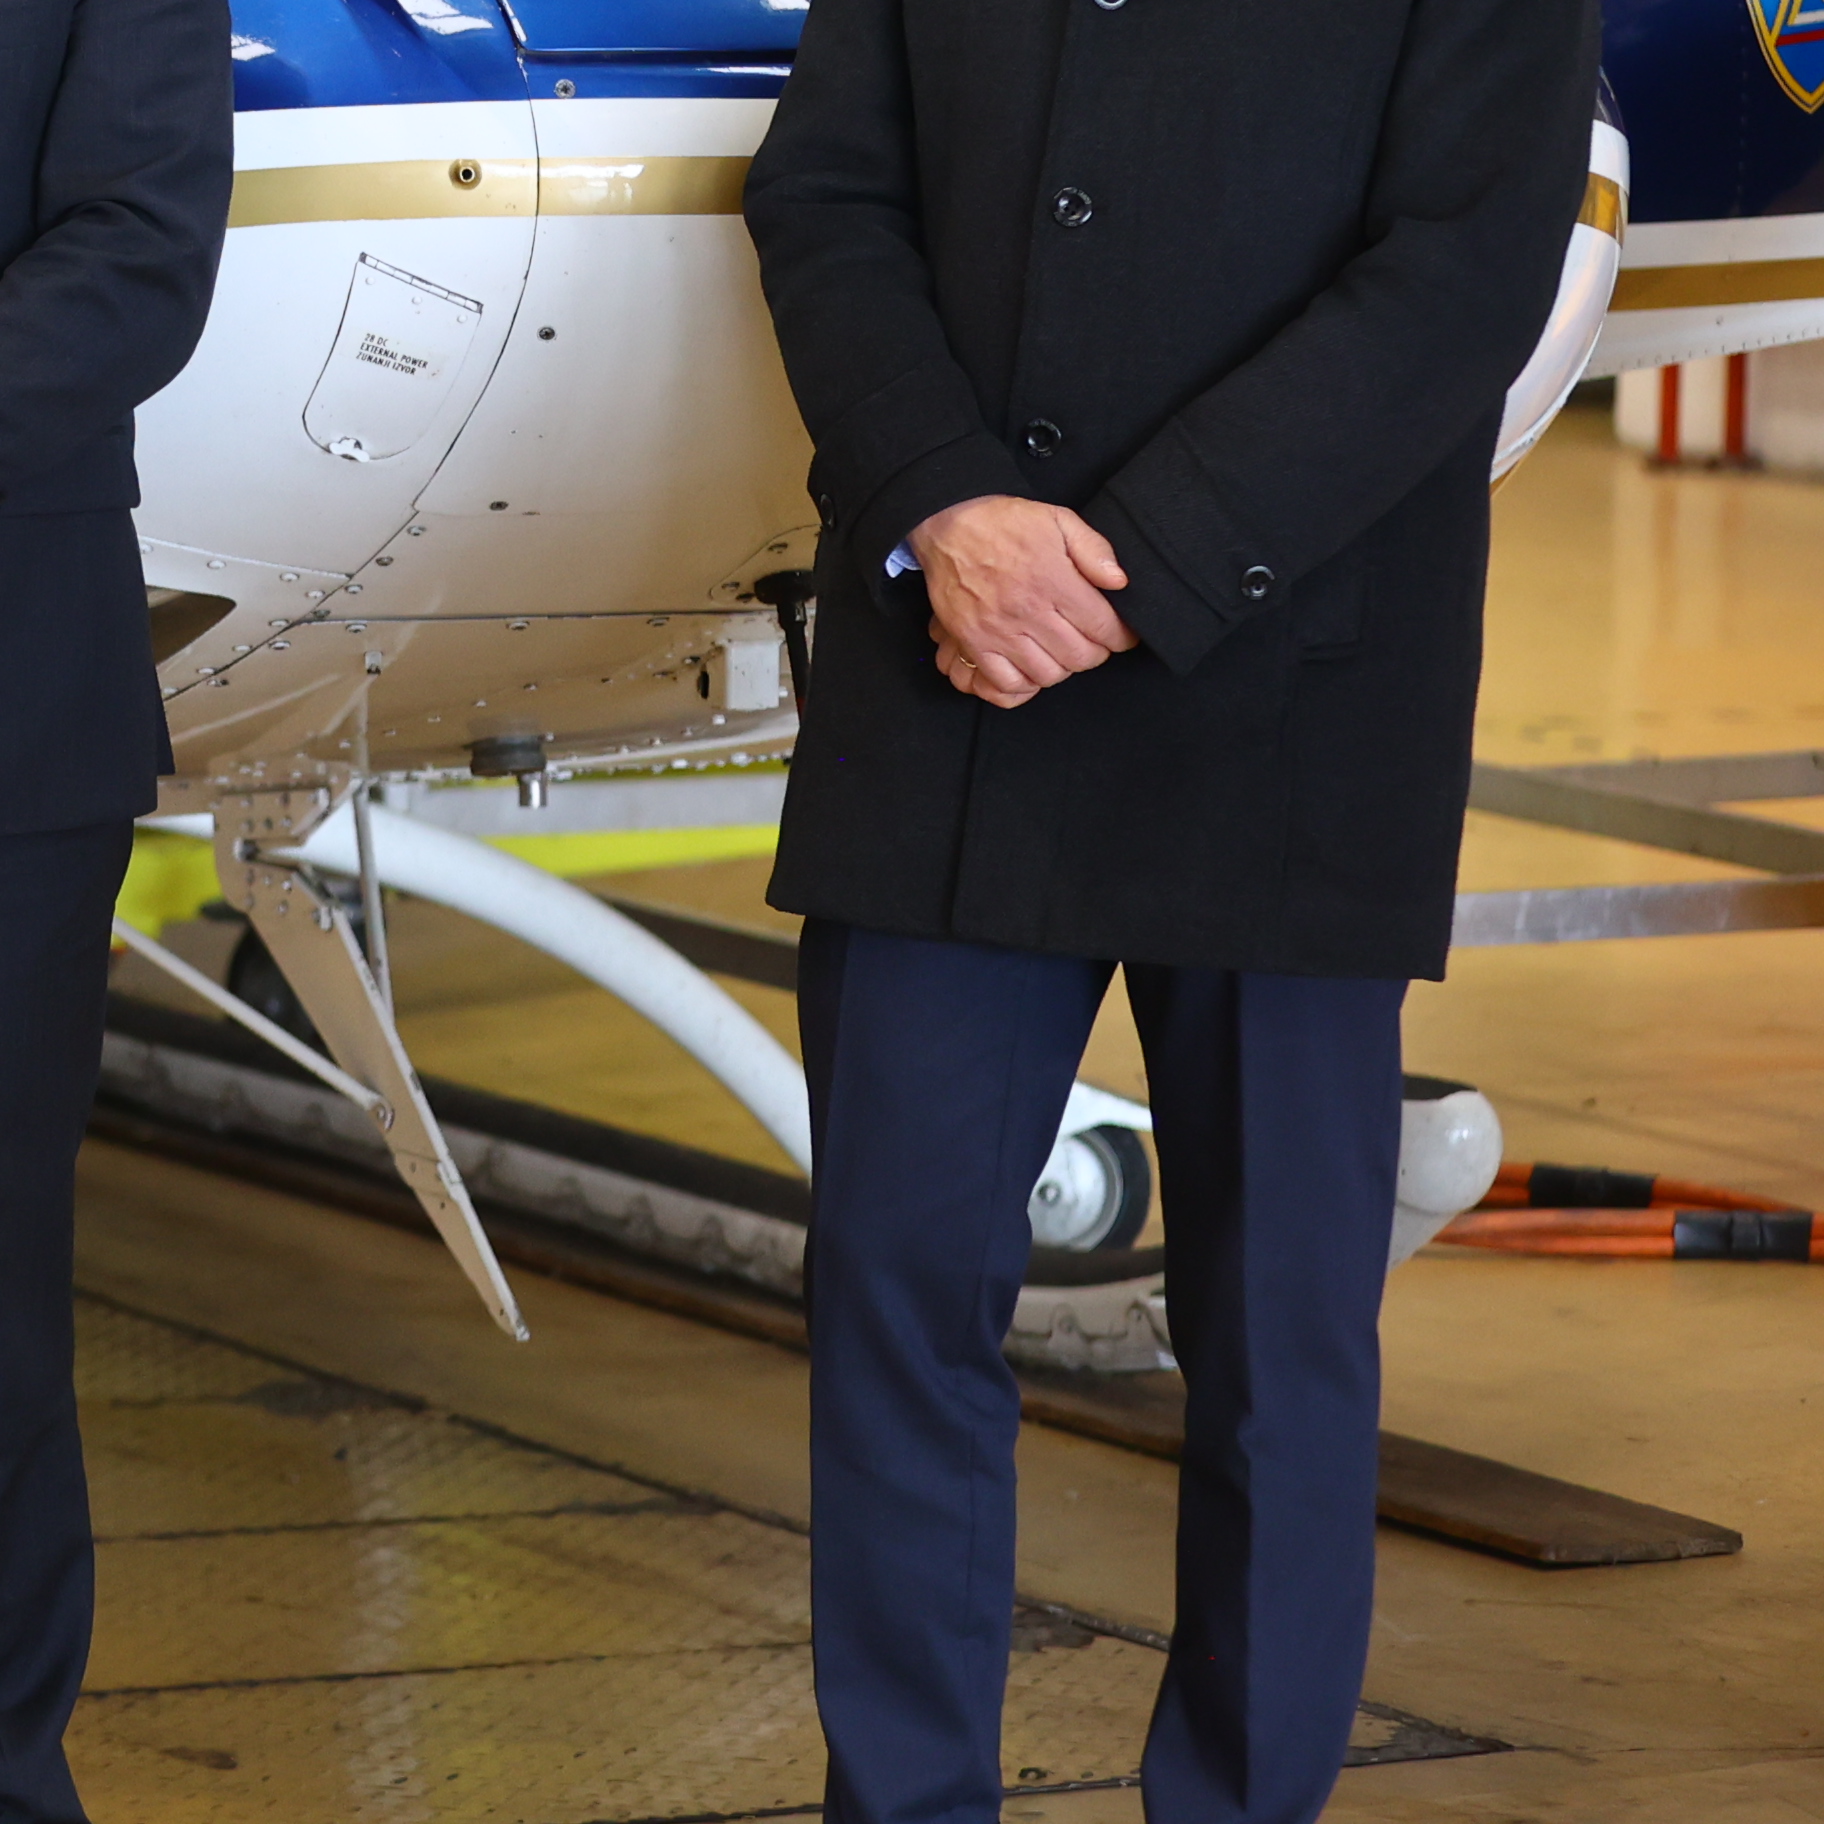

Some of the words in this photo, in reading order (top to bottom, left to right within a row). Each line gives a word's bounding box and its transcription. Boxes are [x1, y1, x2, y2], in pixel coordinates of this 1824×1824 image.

[364, 333, 376, 343] 28
[355, 351, 392, 368] ZUNANJI
[391, 362, 417, 376] IZVOR
[359, 342, 398, 361] EXTERNAL
[400, 354, 429, 369] POWER
